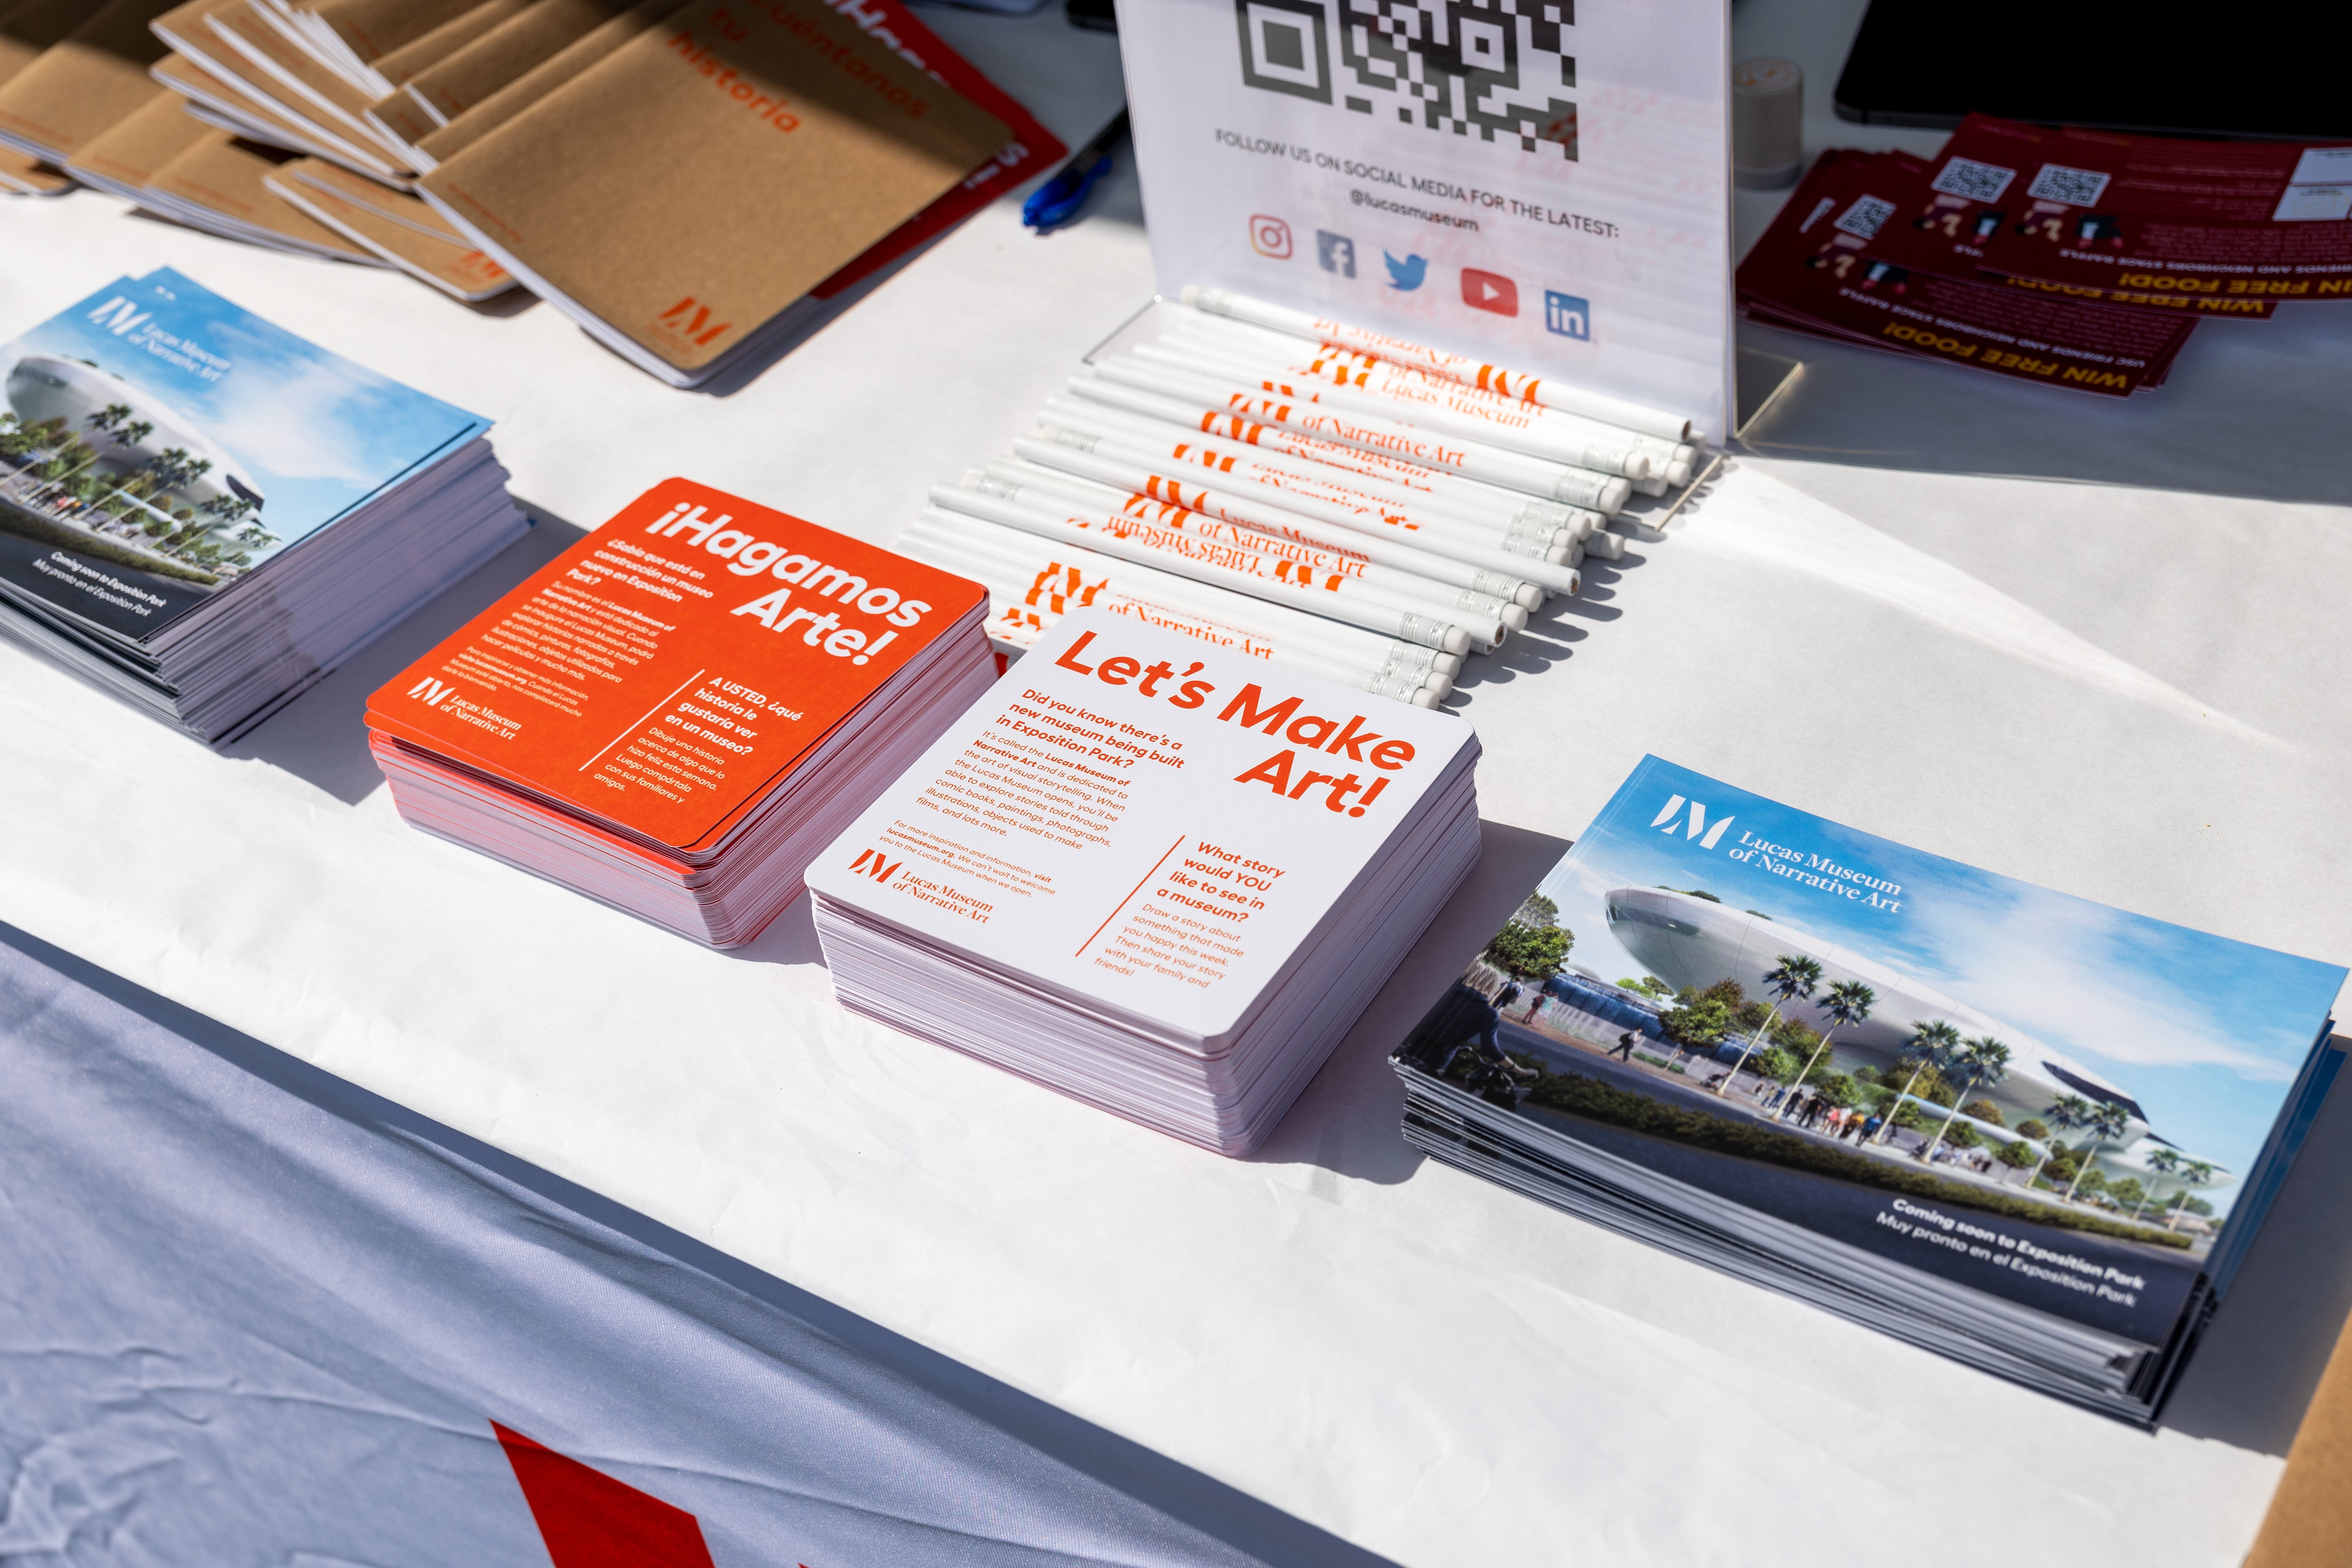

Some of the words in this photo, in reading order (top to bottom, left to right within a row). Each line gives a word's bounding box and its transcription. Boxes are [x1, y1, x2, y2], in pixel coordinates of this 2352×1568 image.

[666, 29, 799, 132] historia
[748, 0, 930, 118] uéntanos
[1216, 129, 1286, 156] FOLLOW
[1290, 147, 1311, 163] US
[1315, 153, 1340, 171] ON
[1344, 160, 1406, 189] SOCIAL
[1411, 176, 1468, 202] MEDIA
[1470, 189, 1505, 212] FOR
[1509, 199, 1543, 221] THE
[1548, 209, 1619, 238] LATEST:
[1349, 189, 1480, 232] @lucasmuseum
[2118, 272, 2220, 292] FOOD!
[2227, 279, 2310, 294] FREE
[1883, 322, 1978, 358] FOOD!
[1980, 348, 2058, 376] FREE
[2063, 367, 2128, 389] WIN
[1301, 415, 1324, 432] of
[1329, 419, 1427, 457] Narrative
[1430, 445, 1466, 468] Art
[1199, 522, 1223, 538] of
[1222, 527, 1327, 566] Narrative
[1329, 555, 1368, 578] Art
[730, 588, 898, 665] Arte!
[677, 702, 735, 729] gustaría
[734, 725, 757, 738] ver
[694, 688, 744, 715] historia
[742, 709, 757, 720] le
[709, 677, 722, 687] A
[722, 681, 766, 708] USTED,
[768, 702, 804, 720] ¿qué
[1022, 689, 1050, 704] Did
[1047, 700, 1076, 714] you
[1076, 708, 1118, 728] know
[1120, 723, 1170, 746] there's
[1055, 631, 1215, 709] Let's
[1217, 683, 1415, 770] Make
[665, 715, 682, 726] en
[682, 722, 701, 733] un
[699, 730, 753, 755] museo?
[983, 730, 996, 740] It's
[998, 738, 1028, 751] called
[1028, 748, 1044, 757] the
[1044, 753, 1074, 768] Lucas
[1074, 763, 1116, 782] Museum
[996, 715, 1011, 726] in
[1012, 720, 1087, 753] Exposition
[1088, 747, 1134, 768] Park?
[1009, 704, 1041, 719] new
[1041, 715, 1104, 742] museum
[1105, 735, 1148, 758] being
[1148, 750, 1184, 768] built
[955, 759, 971, 769] the
[971, 765, 1001, 780] Lucas
[1001, 775, 1043, 795] Museum
[1044, 793, 1074, 808] opens,
[1077, 804, 1105, 817] you'll
[1104, 813, 1118, 822] be
[964, 750, 980, 759] the
[981, 757, 997, 766] art
[1009, 766, 1038, 780] visual
[1037, 777, 1092, 801] storytelling.
[1096, 796, 1125, 811] When
[973, 740, 1019, 760] Narrative
[1019, 757, 1037, 767] Art
[1037, 765, 1058, 774] and
[1067, 775, 1118, 795] dedicated
[1234, 750, 1390, 817] Art!
[916, 797, 939, 811] films,
[942, 808, 963, 818] and
[962, 814, 980, 826] lots
[980, 822, 1006, 836] more.
[925, 787, 980, 813] illustrations,
[982, 810, 1018, 826] objects
[1018, 823, 1044, 835] used
[1054, 836, 1083, 849] make
[935, 779, 965, 793] comic
[965, 789, 995, 806] books,
[996, 802, 1044, 824] paintings,
[1045, 820, 1110, 847] photographs,
[945, 769, 966, 780] able
[979, 782, 1014, 798] explore
[1014, 795, 1048, 810] stories
[1049, 806, 1070, 818] told
[1069, 814, 1109, 832] through
[894, 819, 908, 828] For
[907, 826, 928, 837] more
[928, 833, 969, 852] inspiration
[969, 849, 986, 858] and
[985, 855, 1031, 877] information,
[1034, 873, 1052, 883] visit
[1184, 858, 1233, 879] would
[1236, 872, 1272, 891] YOU
[1198, 842, 1241, 864] What
[1242, 860, 1285, 878] story
[1738, 831, 1804, 862] Lucas
[1804, 853, 1901, 895] Museum
[892, 882, 911, 891] of
[907, 886, 967, 914] Narrative
[966, 910, 989, 923] Art
[901, 871, 939, 891] Lucas
[938, 885, 993, 912] Museum
[1157, 889, 1169, 897] a
[1169, 893, 1249, 922] museum?
[1169, 871, 1198, 887] like
[1200, 882, 1217, 894] to
[1219, 890, 1247, 904] see
[1249, 897, 1265, 909] in
[1729, 849, 1759, 862] of
[1755, 854, 1860, 899] Narrative
[1860, 892, 1902, 913] Art
[1876, 1211, 1912, 1233] Muy
[1912, 1227, 1968, 1252] pronto
[1969, 1246, 1991, 1260] en
[1993, 1254, 2010, 1265] el
[2010, 1257, 2095, 1293] Exposition
[2096, 1285, 2135, 1306] Park
[1893, 1198, 1955, 1230] Coming
[1956, 1223, 1996, 1242] soon
[1998, 1235, 2016, 1248] to
[2016, 1240, 2103, 1276] Exposition
[2104, 1267, 2144, 1289] Park
